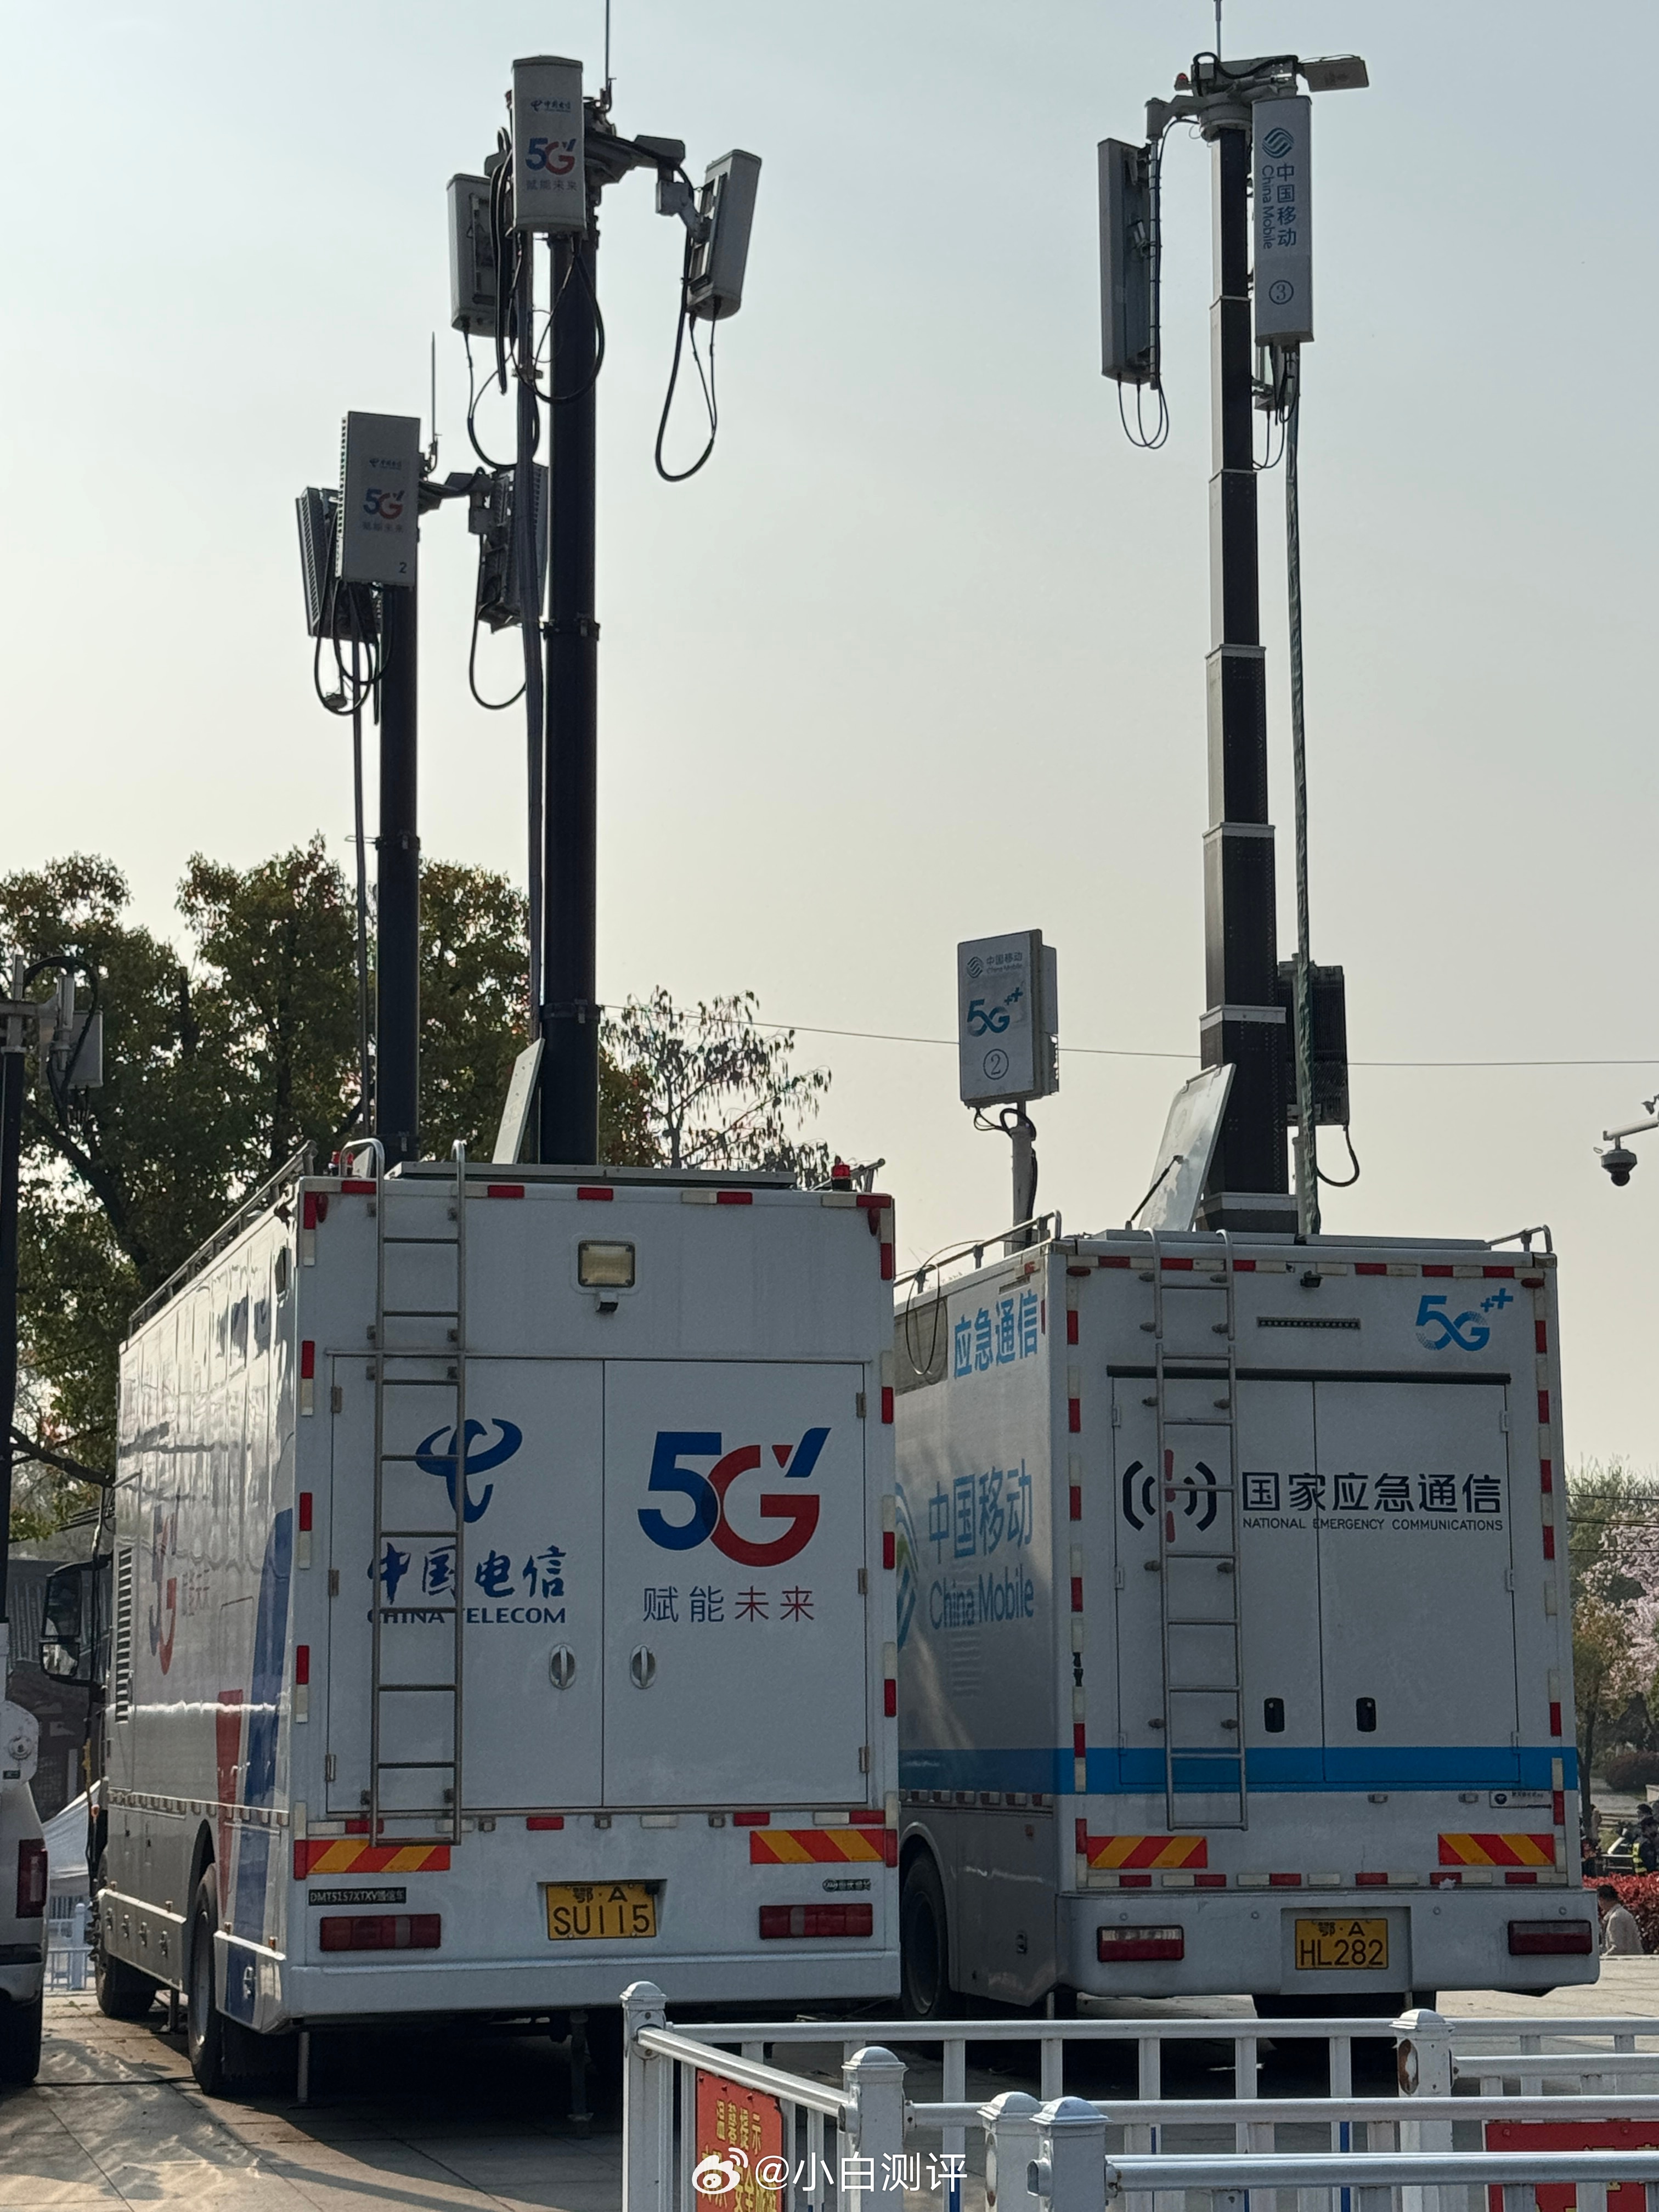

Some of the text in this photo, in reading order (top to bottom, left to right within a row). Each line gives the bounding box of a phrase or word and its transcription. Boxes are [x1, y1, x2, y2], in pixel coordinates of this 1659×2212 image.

[526, 138, 577, 175] 5G
[1262, 165, 1276, 249] China Mobile
[1277, 163, 1296, 247] 中国移动
[363, 488, 404, 519] 5G
[399, 562, 407, 573] 2
[987, 952, 1023, 965] 中国移动
[955, 1288, 1039, 1380] 应急通信
[637, 1427, 832, 1567] 5G
[1243, 1472, 1501, 1513] 国家应急通信
[929, 1458, 1033, 1565] 中国移动
[1243, 1518, 1306, 1529] NATIONAL
[1313, 1519, 1384, 1530] EMERGENCY
[367, 1542, 566, 1605] 中国电信
[461, 1607, 566, 1623] ELECOM
[643, 1585, 815, 1622] 赋能未来
[930, 1564, 1034, 1630] China Mobile
[554, 1904, 649, 1936] SU115
[1301, 1939, 1383, 1966] HL282
